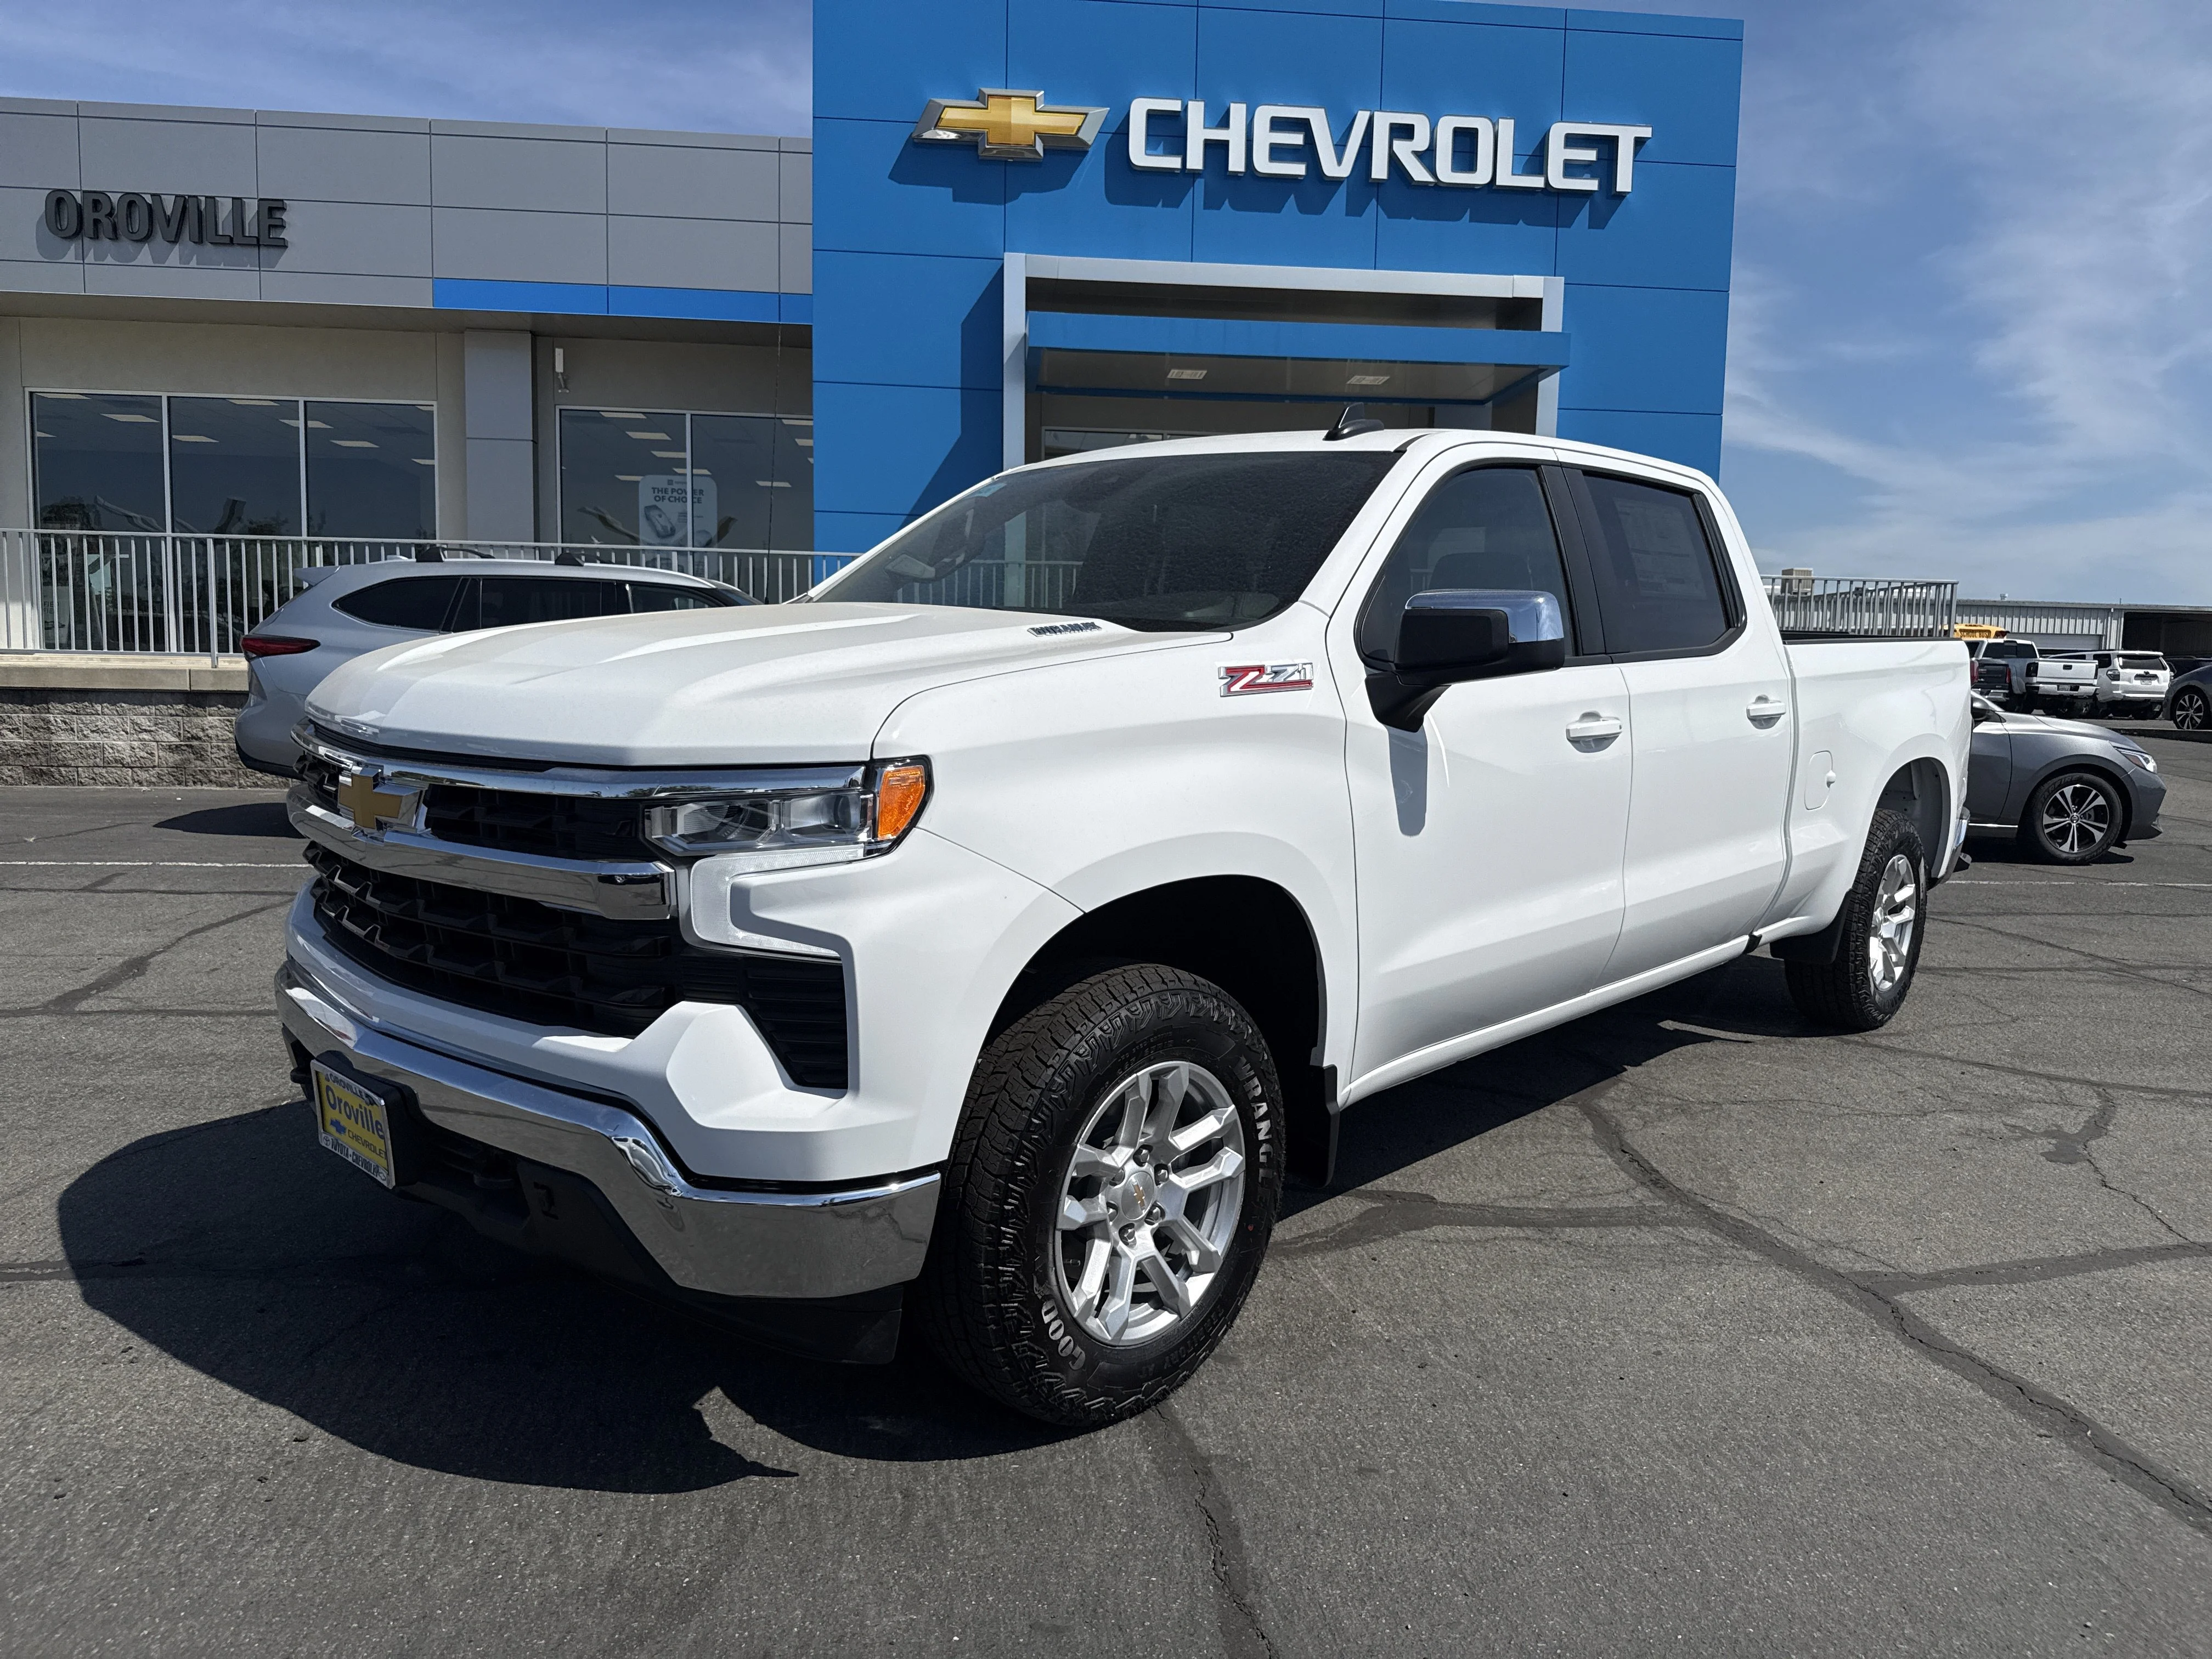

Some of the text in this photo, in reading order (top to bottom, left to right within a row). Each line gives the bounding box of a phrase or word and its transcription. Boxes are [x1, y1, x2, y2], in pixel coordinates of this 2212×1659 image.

[1128, 97, 1654, 195] CHEVROLET
[44, 189, 288, 248] OROVILLE
[671, 488, 704, 496] POER
[1027, 622, 1102, 637] DURAMAX
[1218, 662, 1314, 697] Z71
[329, 1073, 365, 1099] OROVILLE
[325, 1085, 385, 1139] Oroville
[331, 1138, 349, 1159] TOYOTA
[348, 1129, 387, 1160] CHEVROLET
